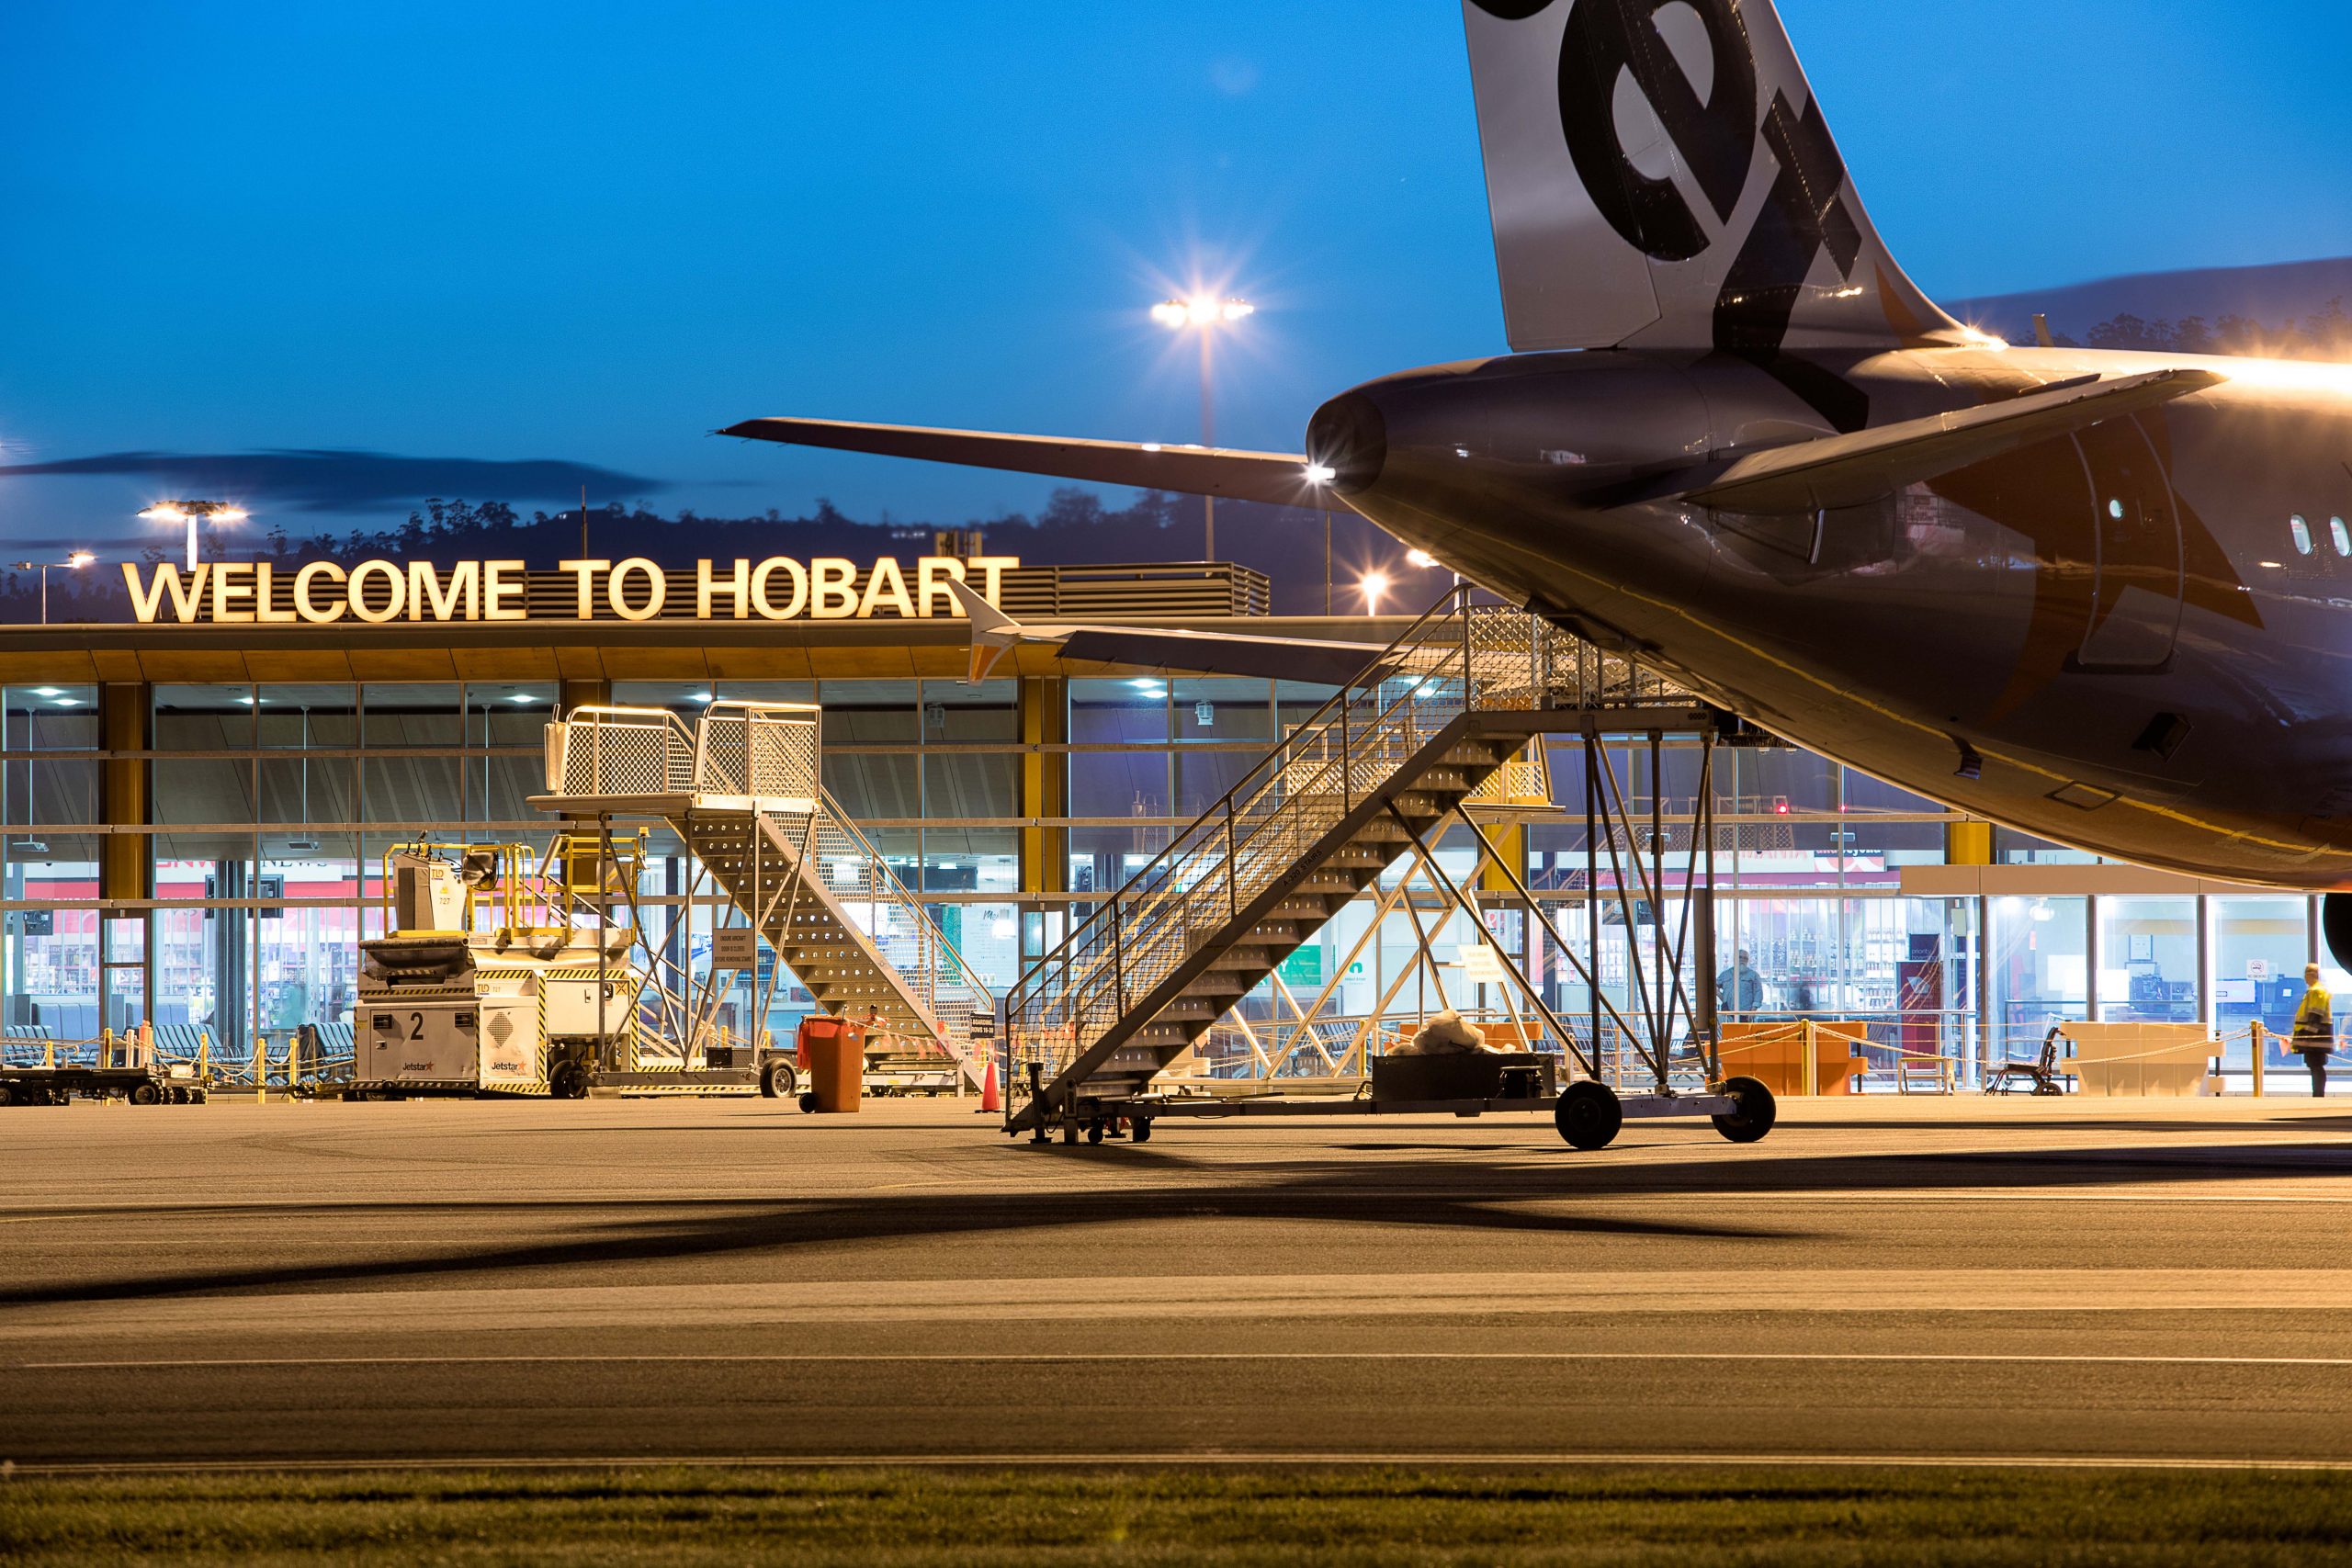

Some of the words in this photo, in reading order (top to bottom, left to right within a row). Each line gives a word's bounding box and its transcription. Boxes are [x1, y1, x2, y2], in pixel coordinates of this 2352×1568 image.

[120, 557, 527, 625] WELCOME
[559, 557, 667, 622] TO
[695, 555, 1020, 620] HOBART
[1300, 851, 1323, 870] STAIRS
[431, 868, 444, 877] TLD
[477, 984, 490, 993] TLD
[410, 1011, 424, 1041] 2
[402, 1062, 426, 1072] Jetstar
[491, 1061, 518, 1071] Jetstar
